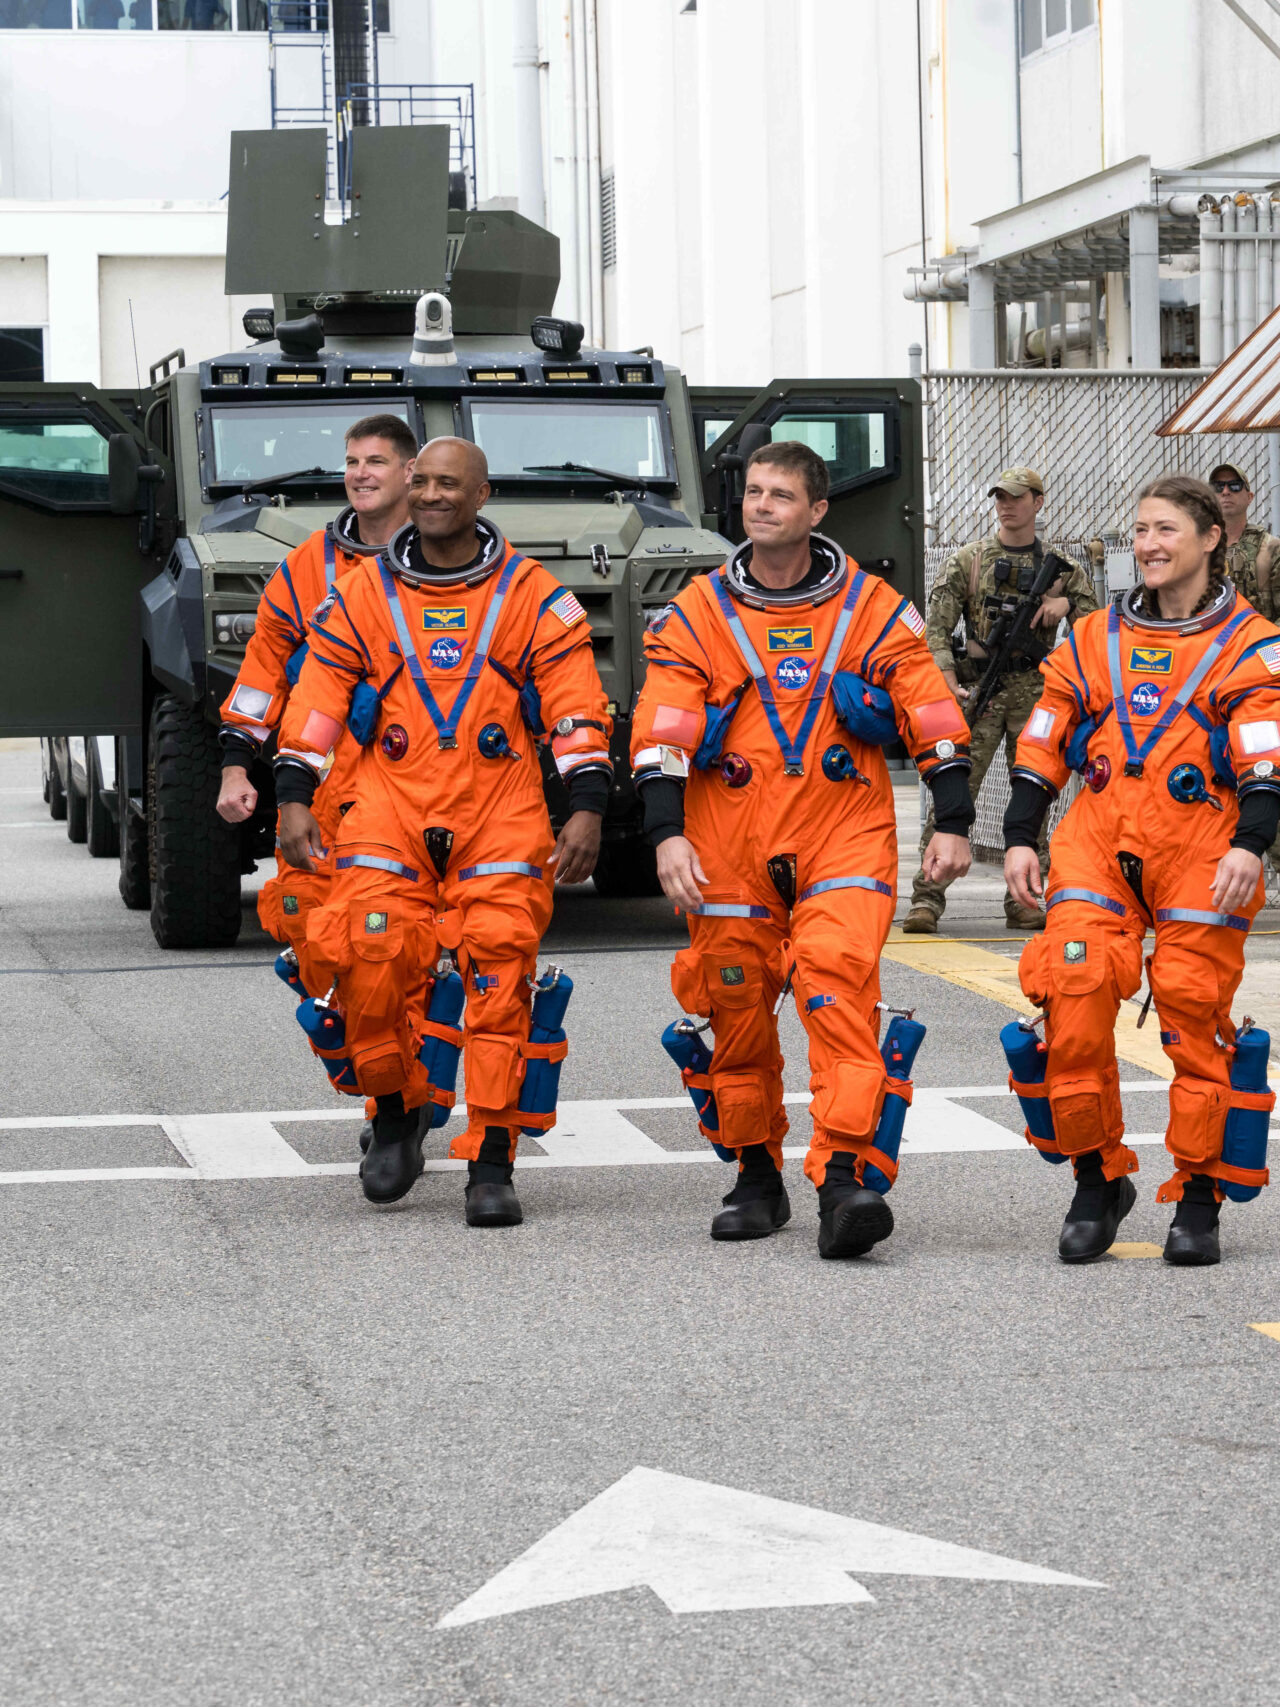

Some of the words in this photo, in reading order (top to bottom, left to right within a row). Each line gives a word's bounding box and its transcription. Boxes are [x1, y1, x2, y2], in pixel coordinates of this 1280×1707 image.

[432, 649, 460, 657] NASA
[778, 668, 808, 678] NASA
[1132, 694, 1159, 704] NASA
